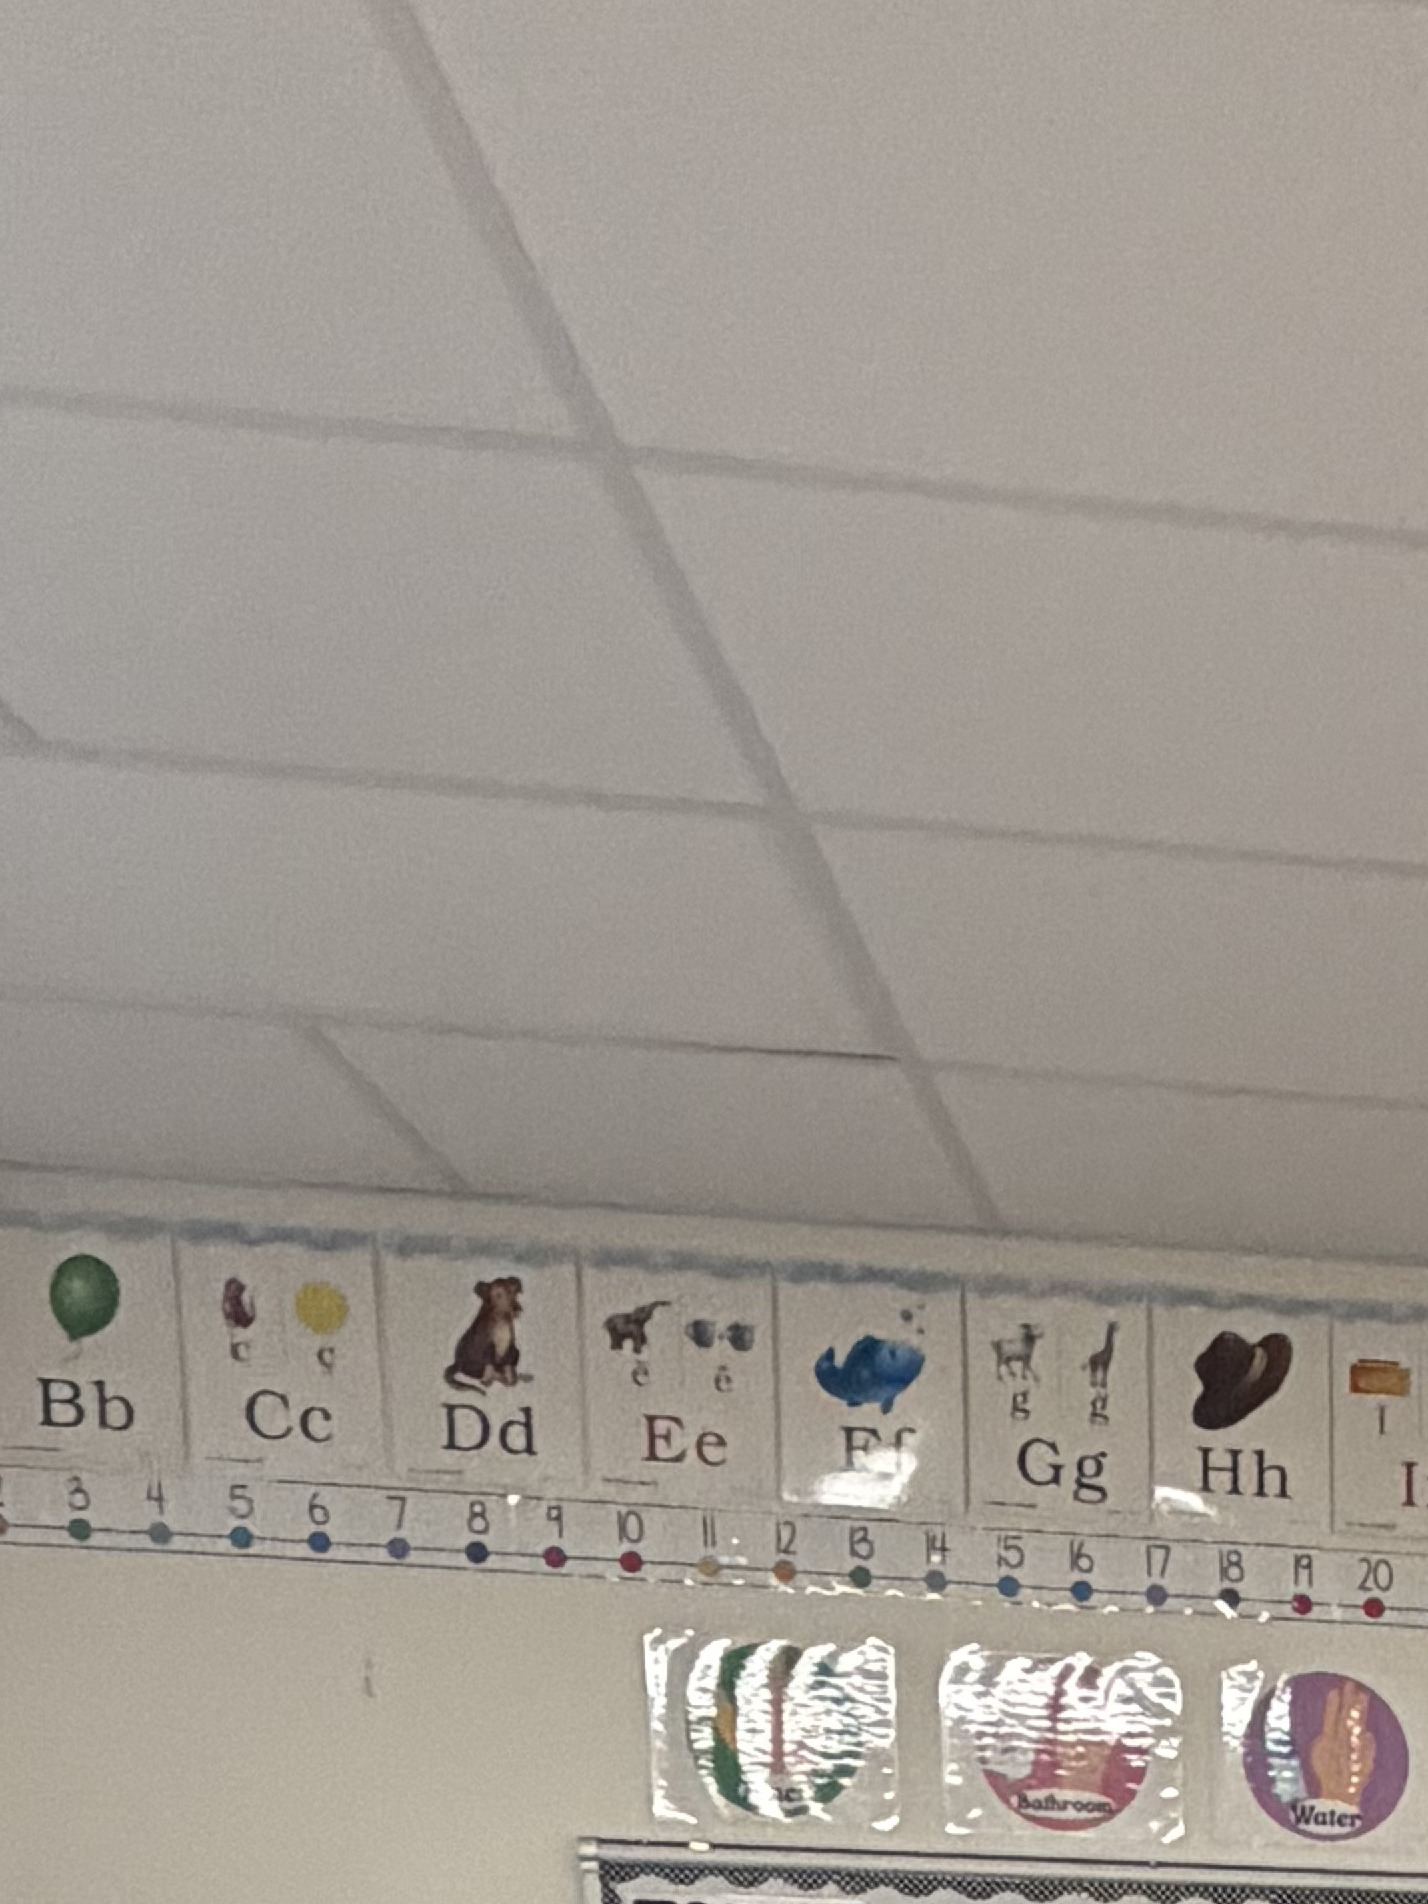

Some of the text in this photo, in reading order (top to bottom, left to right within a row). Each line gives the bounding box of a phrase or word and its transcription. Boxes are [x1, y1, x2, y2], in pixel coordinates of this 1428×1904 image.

[37, 1376, 135, 1433] Bb
[244, 1389, 333, 1444] Cc
[442, 1402, 538, 1457] Dd
[642, 1413, 728, 1466] Ee
[1017, 1437, 1108, 1504] Gg
[1198, 1446, 1291, 1499] Hh
[67, 1477, 90, 1511] 3
[146, 1475, 164, 1511] 4
[229, 1486, 253, 1519] 5
[308, 1492, 329, 1525] 6
[387, 1495, 406, 1530] 7
[466, 1502, 489, 1534] 8
[546, 1505, 565, 1538] 9
[616, 1511, 643, 1542] 10
[702, 1516, 716, 1547] 11
[775, 1521, 796, 1554] 12
[849, 1527, 873, 1559] 13
[925, 1530, 950, 1563] 14
[996, 1535, 1023, 1569] 15
[1068, 1541, 1093, 1573] 16
[1146, 1545, 1170, 1578] 17
[1217, 1550, 1244, 1581] 18
[1293, 1554, 1312, 1586] 19
[1359, 1558, 1393, 1590] 20
[1017, 1791, 1115, 1816] Bathroom
[1290, 1801, 1363, 1832] Water
